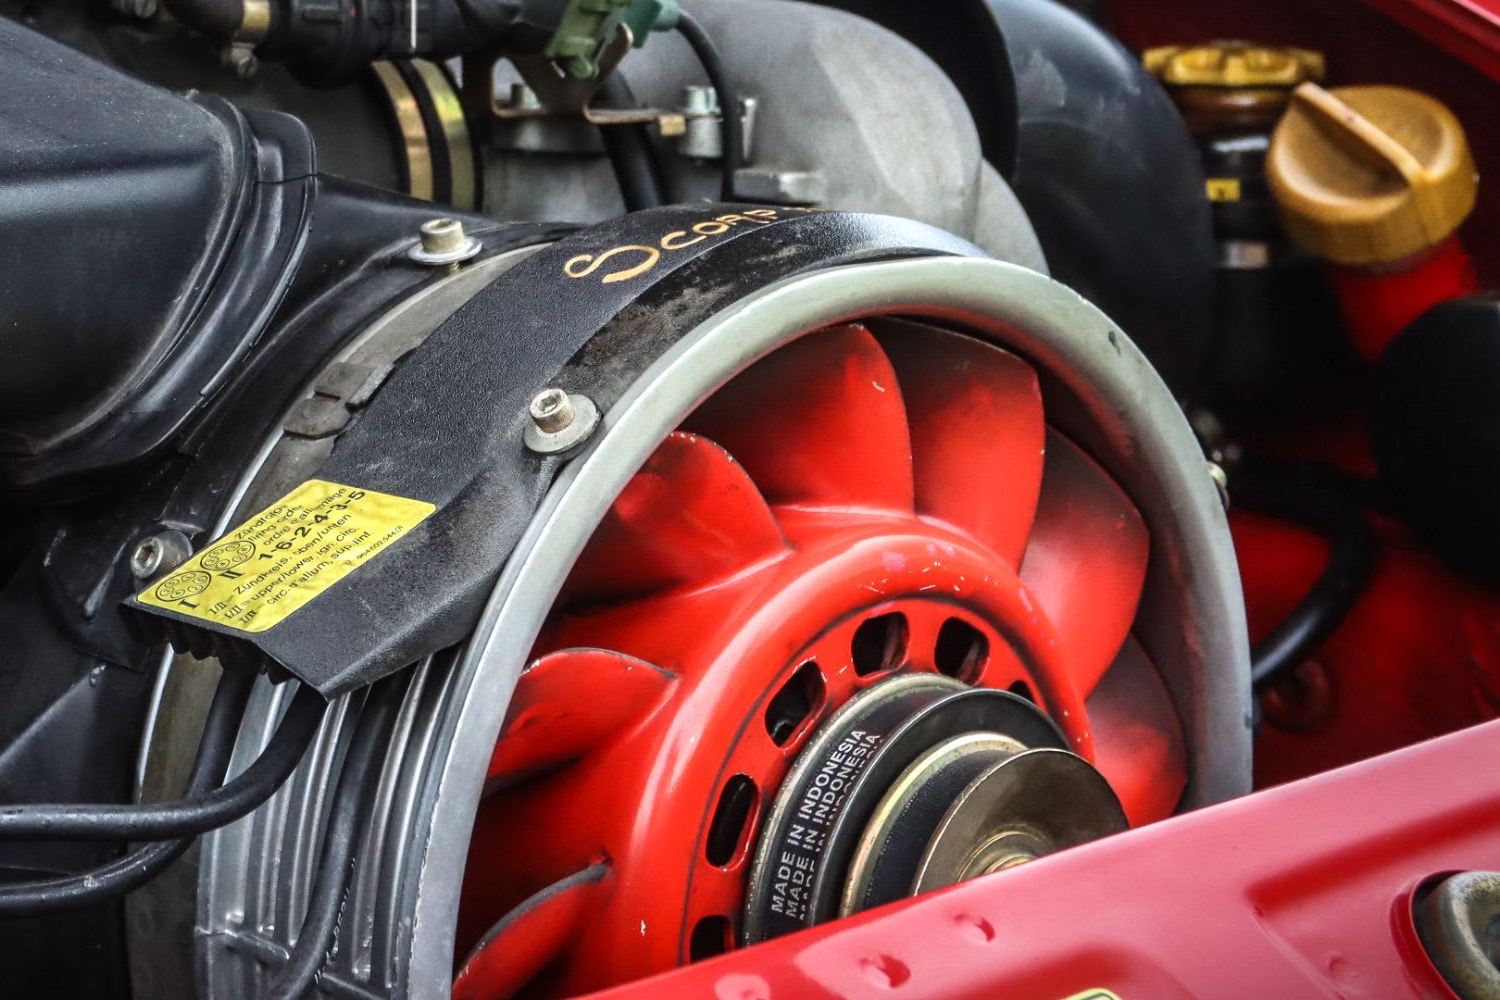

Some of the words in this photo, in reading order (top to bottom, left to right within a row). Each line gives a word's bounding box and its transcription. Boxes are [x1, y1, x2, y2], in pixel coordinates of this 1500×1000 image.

[257, 490, 367, 562] 1-6-2-4-3-5
[771, 853, 796, 913] MADE
[787, 823, 806, 845] IN
[797, 730, 867, 820] INDONESIA
[785, 857, 810, 919] MADE
[802, 829, 819, 851] IN
[812, 735, 882, 826] INDONESIA
